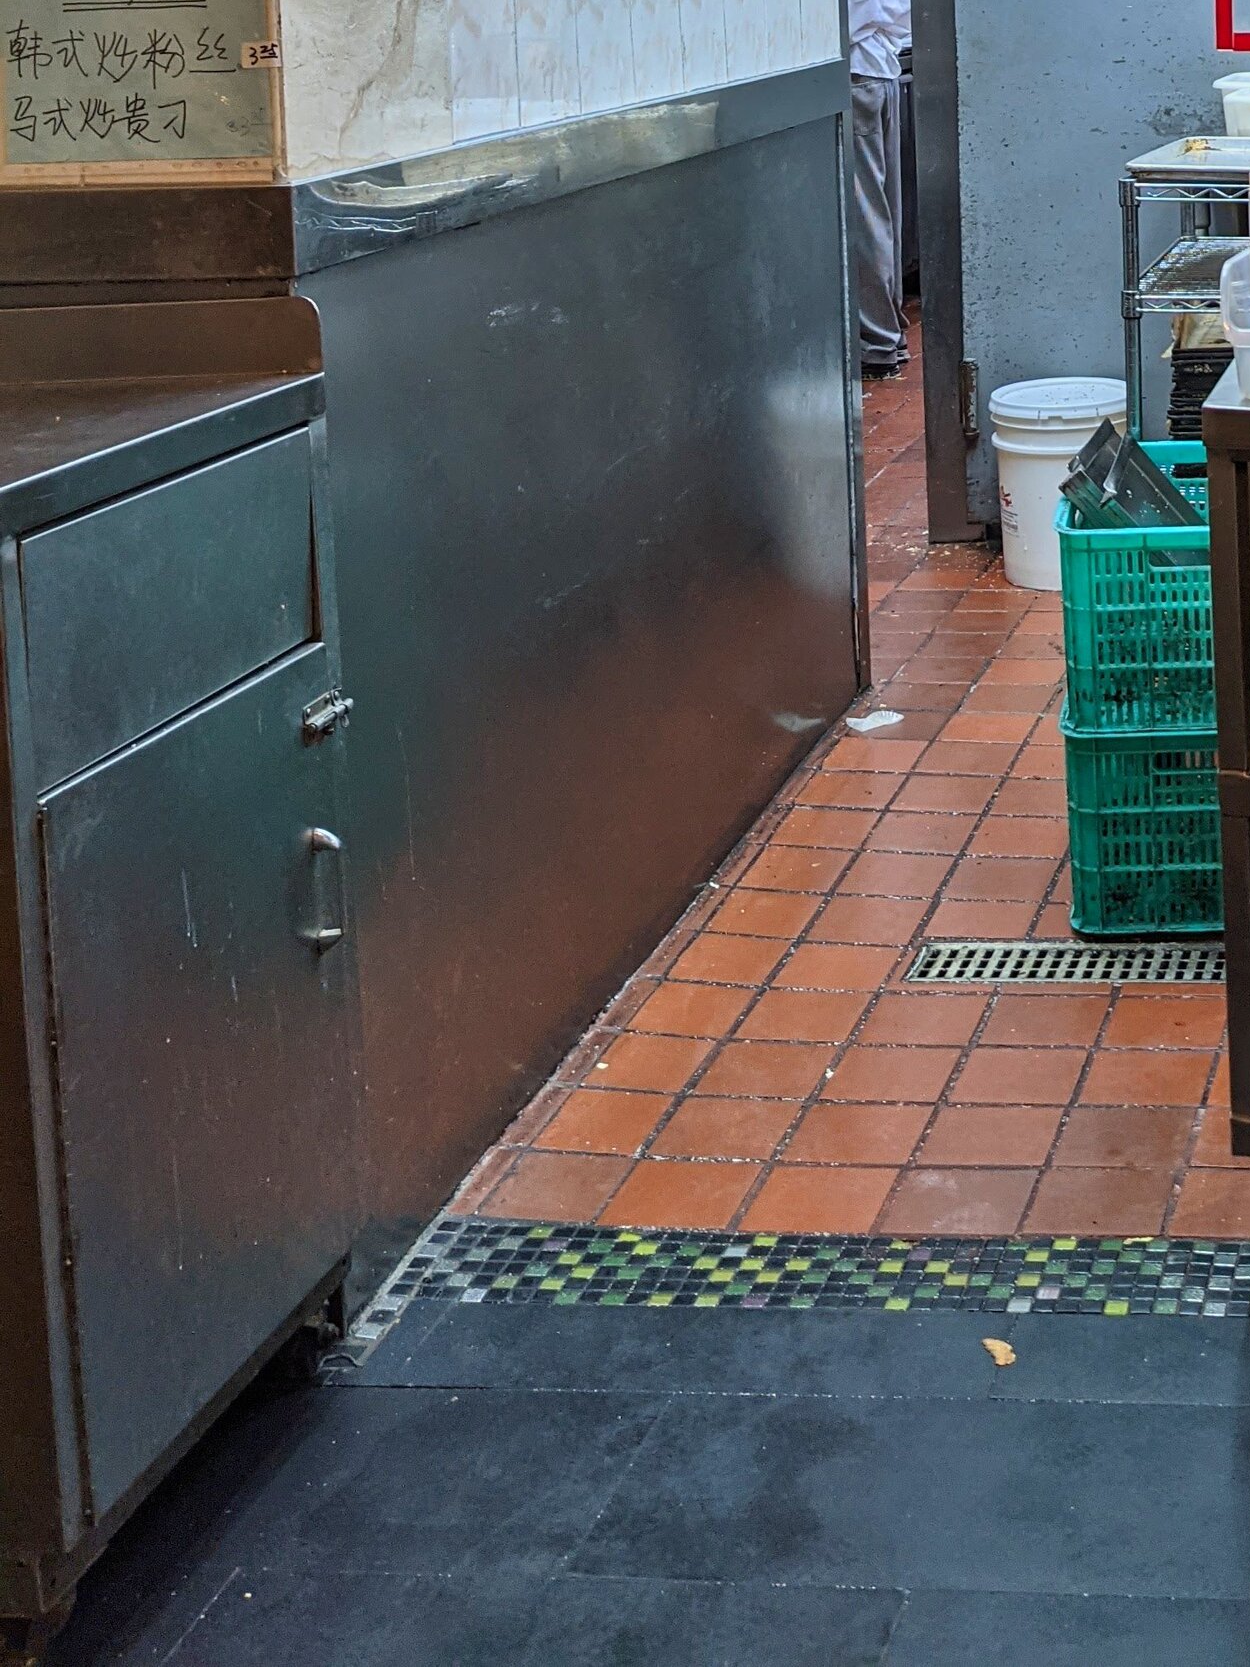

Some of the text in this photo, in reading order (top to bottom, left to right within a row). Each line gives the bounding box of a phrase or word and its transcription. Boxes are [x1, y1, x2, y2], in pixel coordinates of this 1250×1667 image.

[7, 19, 237, 90] 韩式炒粉丝
[9, 92, 188, 143] 马式炒贵刁
